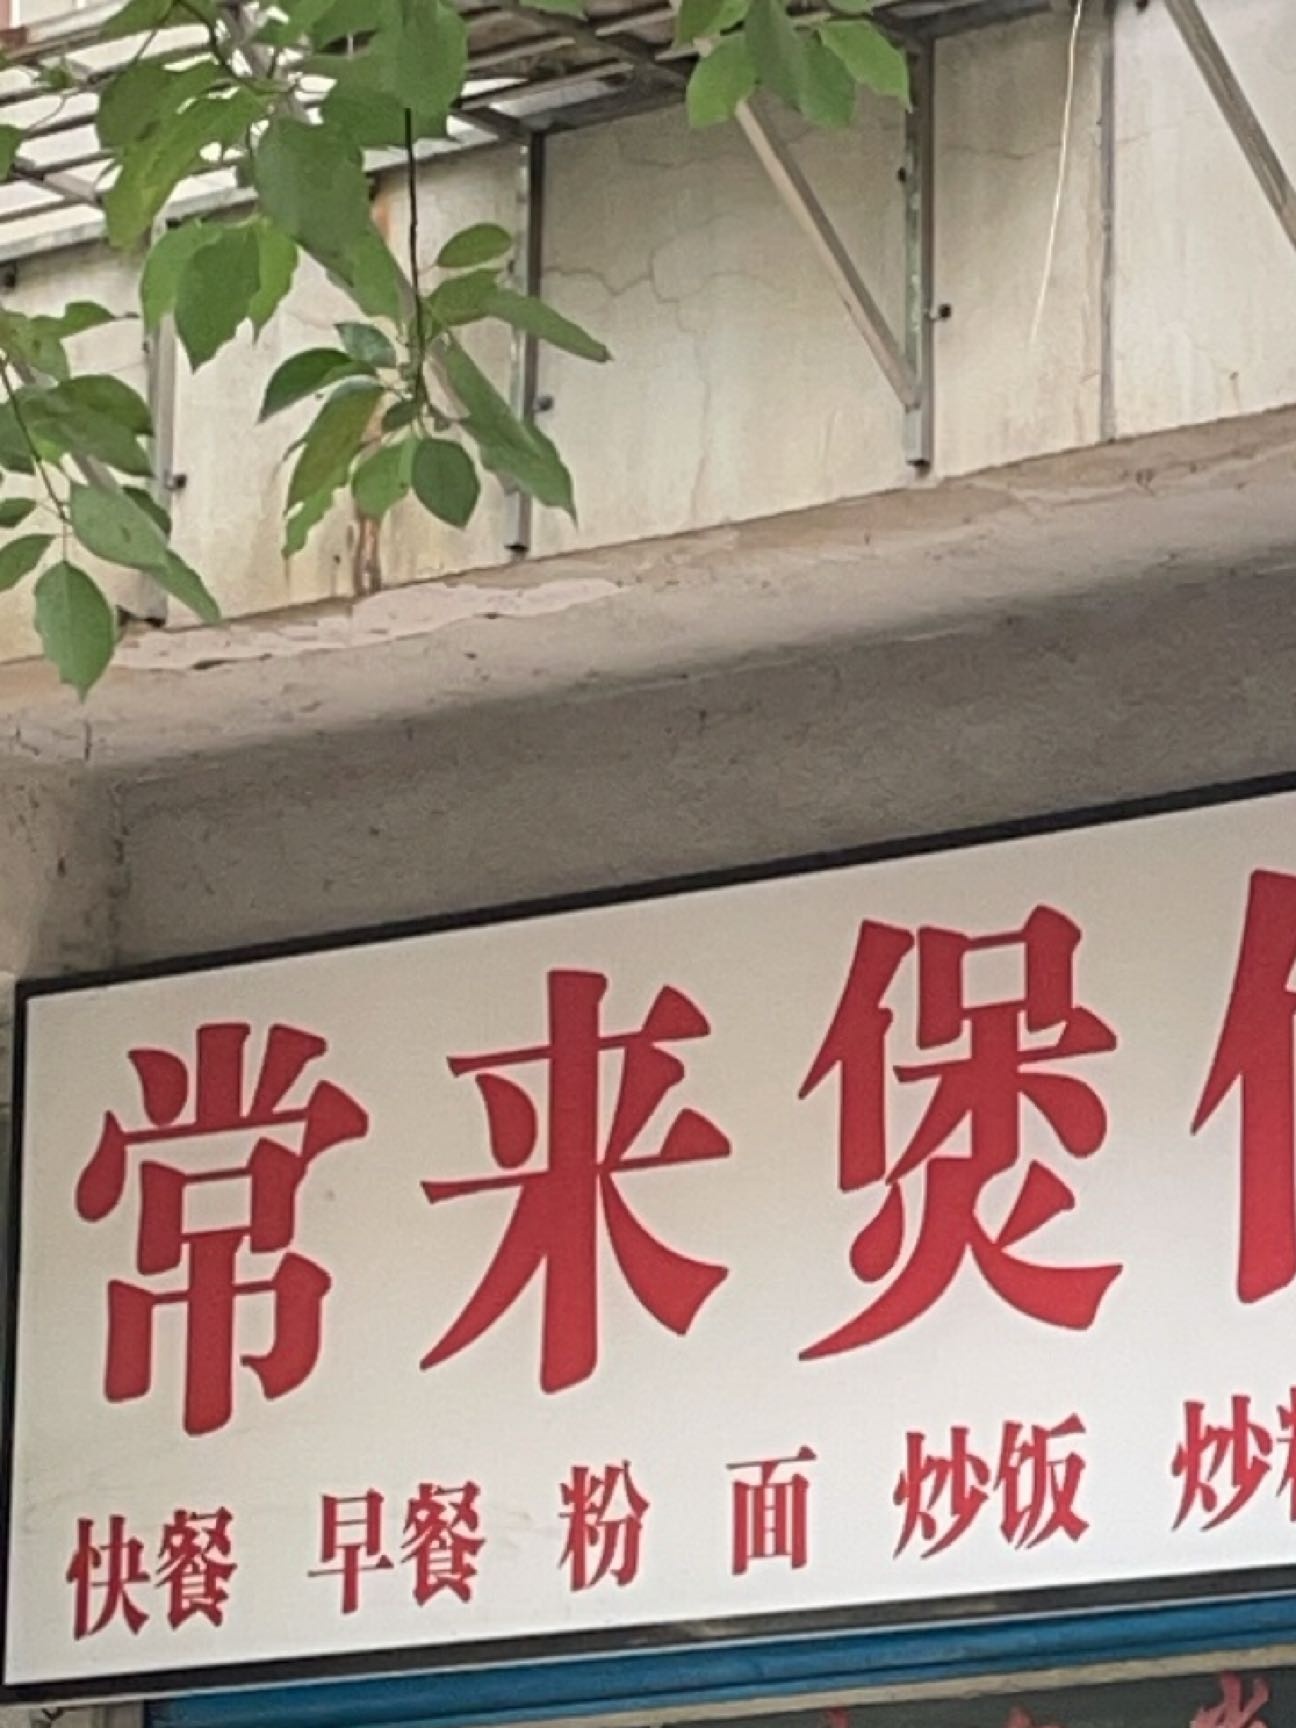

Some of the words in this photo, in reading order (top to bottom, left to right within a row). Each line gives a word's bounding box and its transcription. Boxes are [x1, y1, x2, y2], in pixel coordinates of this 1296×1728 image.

[66, 1506, 238, 1641] 快餐
[308, 1481, 486, 1615] 早餐
[558, 1460, 650, 1592] 粉
[726, 1446, 817, 1576] 面
[892, 1413, 1090, 1560] 炒饭
